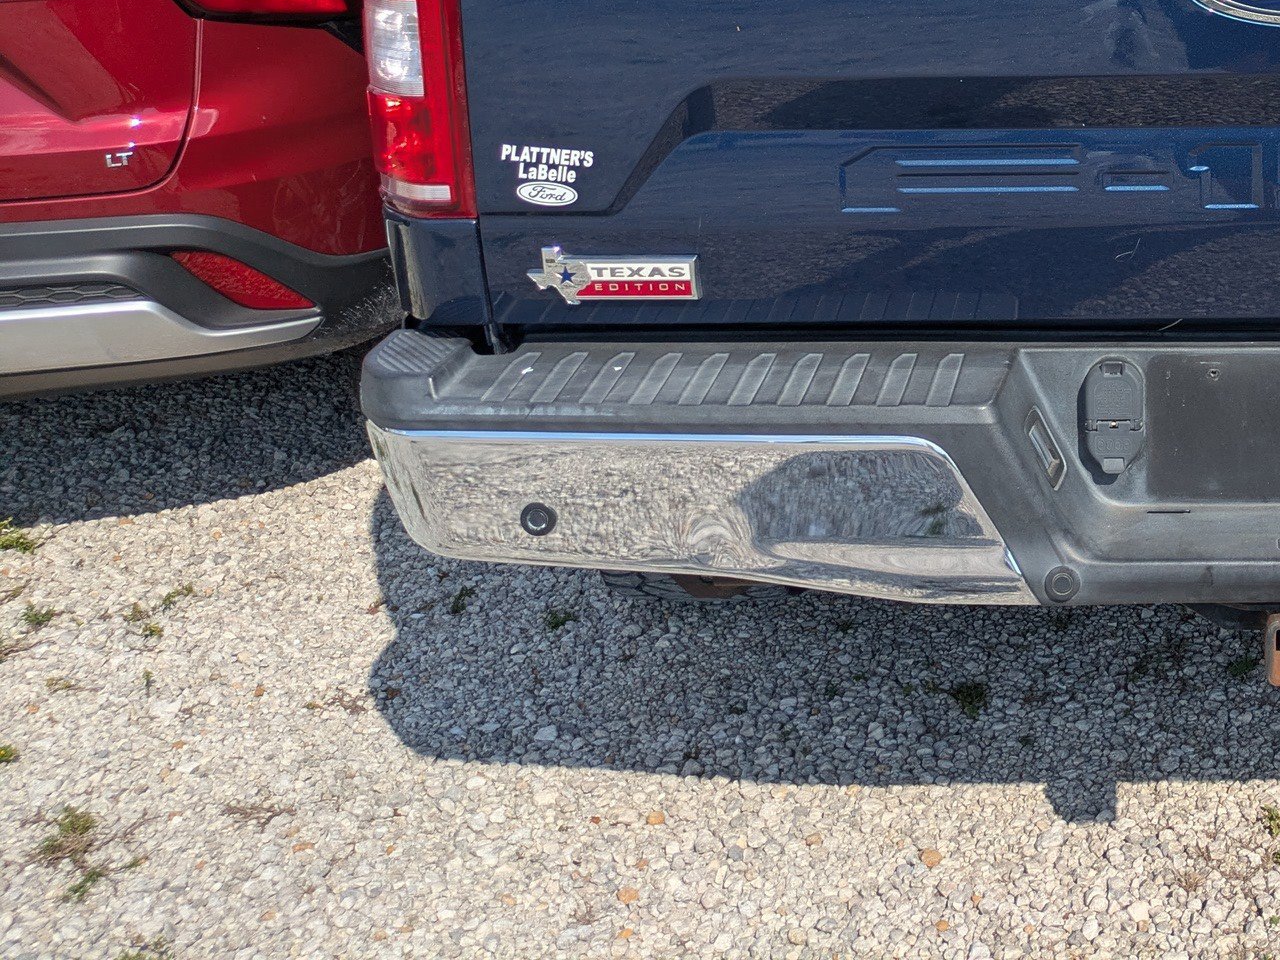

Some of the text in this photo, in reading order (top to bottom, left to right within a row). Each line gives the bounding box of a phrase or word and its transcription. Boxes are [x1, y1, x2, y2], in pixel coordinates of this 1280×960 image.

[105, 151, 133, 168] LT
[501, 144, 594, 167] PLATTNER'S
[518, 163, 577, 183] LaBelle
[528, 185, 567, 202] Ford
[591, 266, 685, 278] TEXAS
[594, 283, 685, 291] EDITION
